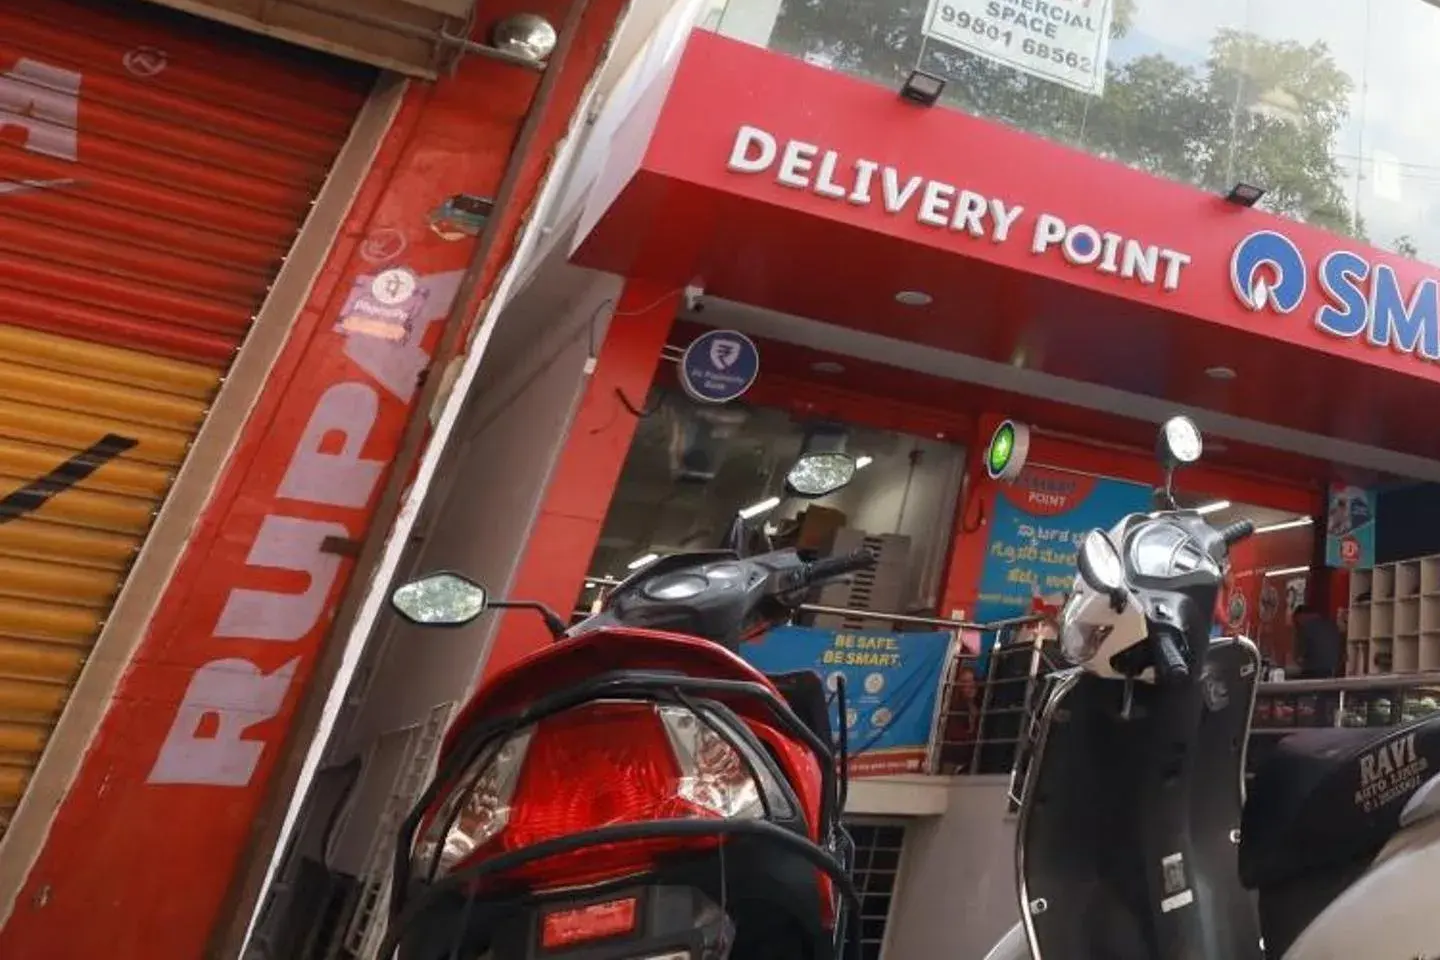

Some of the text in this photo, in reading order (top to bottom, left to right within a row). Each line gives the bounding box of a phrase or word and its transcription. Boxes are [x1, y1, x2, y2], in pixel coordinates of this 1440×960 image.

[941, 4, 1092, 73] 99801 68562
[986, 0, 1059, 40] SPACE
[727, 124, 1192, 292] DELIVERY POINT
[1028, 492, 1067, 508] POINT
[822, 649, 845, 665] BE
[833, 634, 855, 649] BE
[1360, 731, 1417, 786] RAVI
